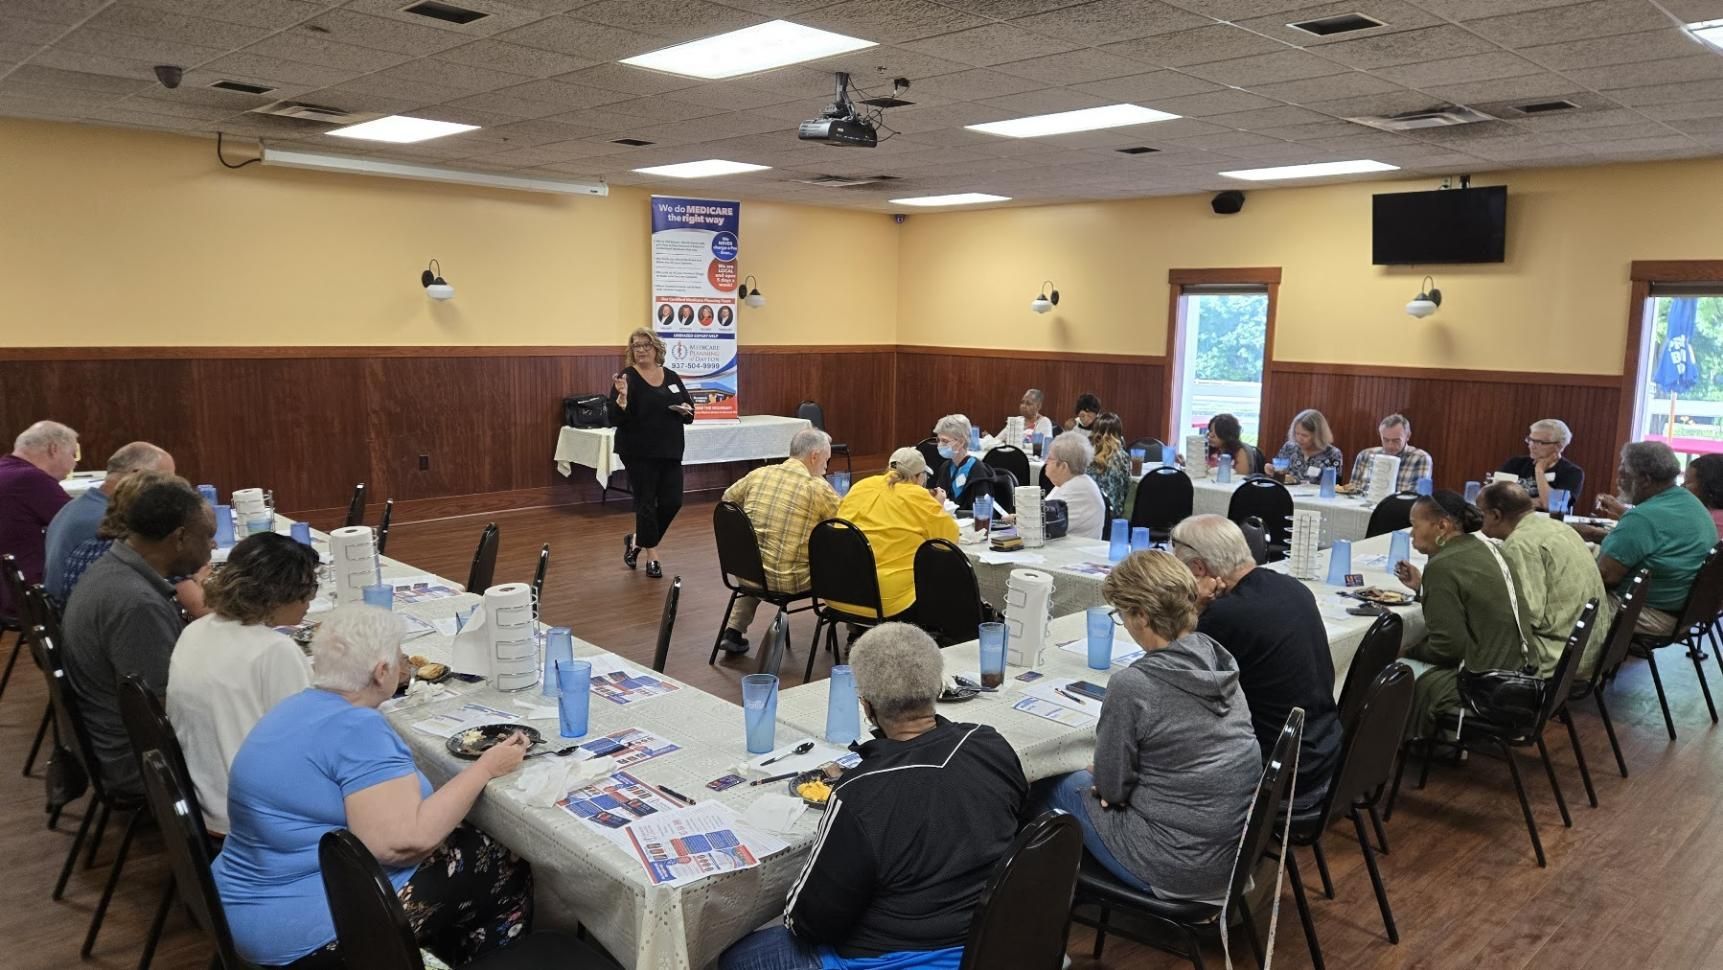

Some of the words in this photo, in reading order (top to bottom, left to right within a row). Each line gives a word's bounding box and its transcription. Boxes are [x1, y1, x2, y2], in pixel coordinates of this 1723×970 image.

[658, 204, 673, 212] We
[674, 205, 686, 213] do
[686, 206, 733, 216] MEDICARE
[682, 214, 704, 224] right
[706, 217, 725, 226] way
